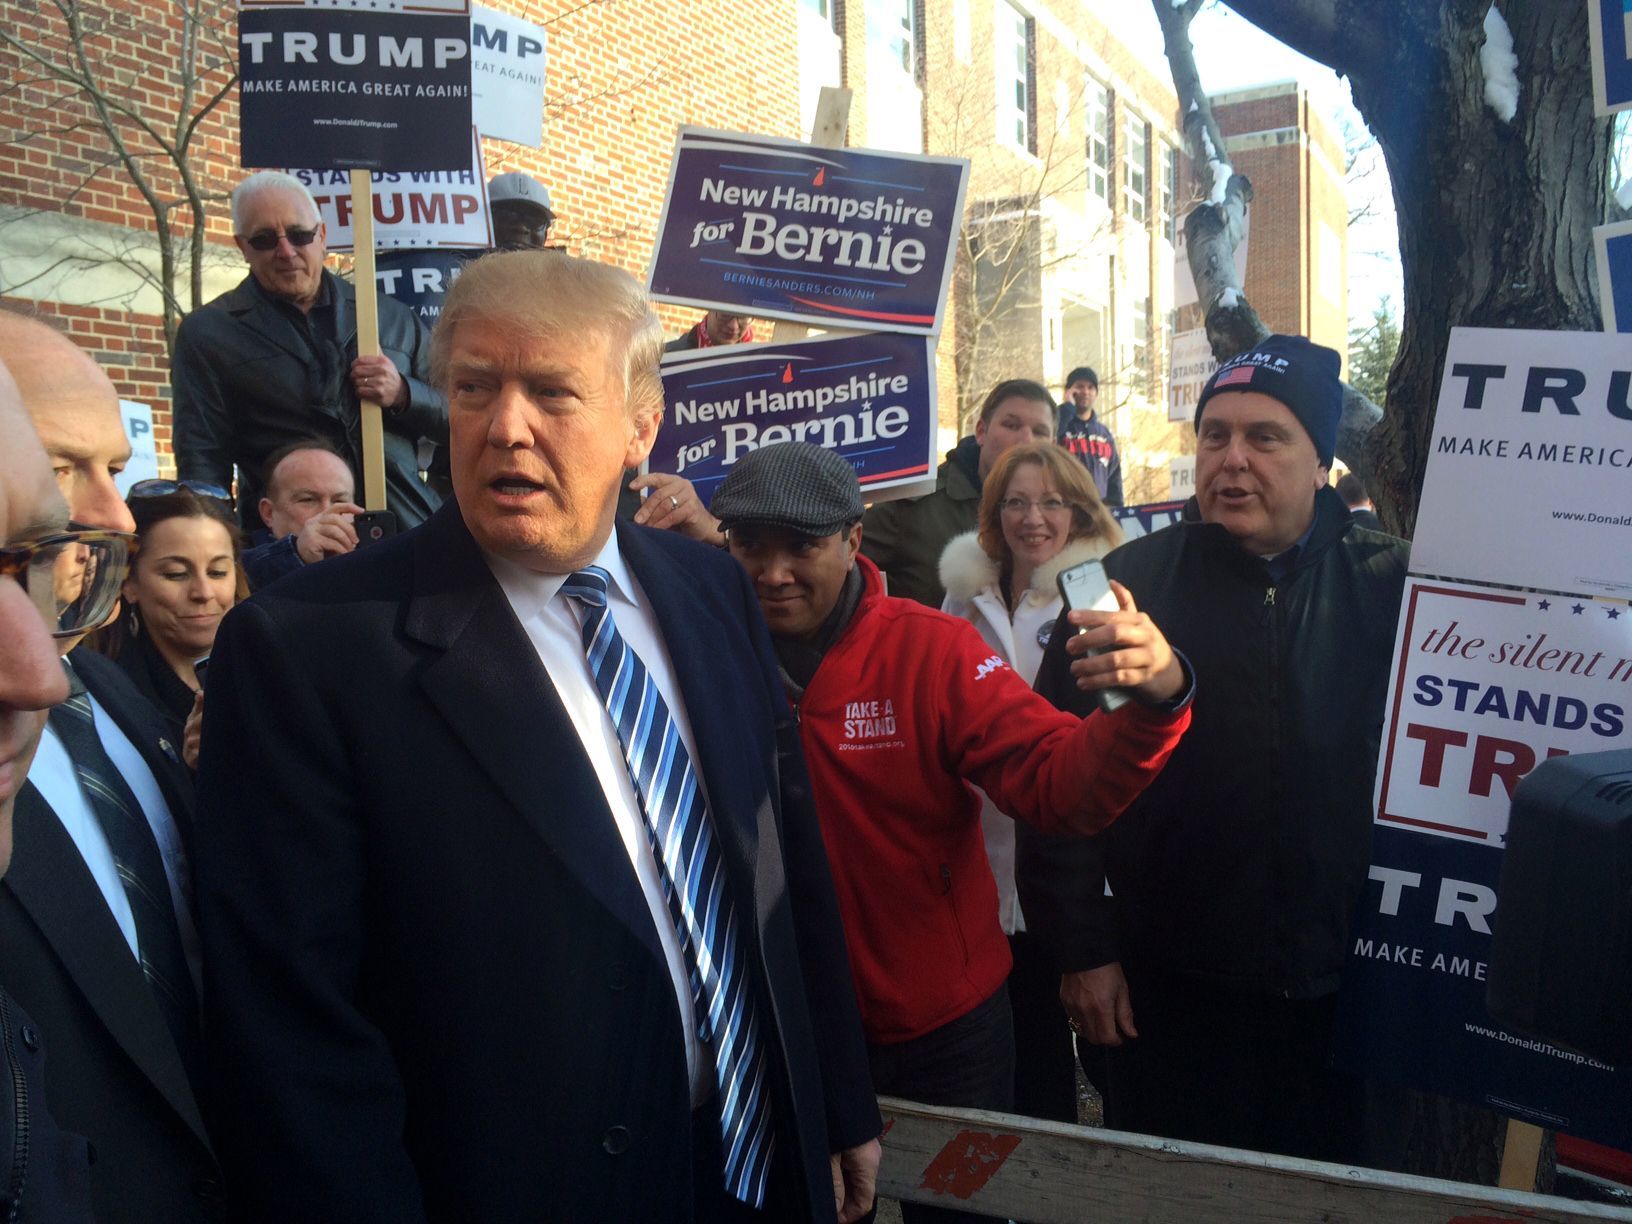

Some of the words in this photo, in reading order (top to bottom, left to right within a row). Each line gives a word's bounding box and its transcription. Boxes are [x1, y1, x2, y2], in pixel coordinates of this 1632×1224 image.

[241, 31, 468, 69] TRUMP
[242, 79, 284, 94] MAKE
[288, 80, 358, 94] AMERICA
[362, 82, 412, 97] GREAT
[415, 84, 468, 98] AGAIN!
[313, 117, 398, 130] www.DonaldJTrump.com
[297, 169, 401, 187] STADS
[411, 170, 475, 185] WITH
[700, 177, 767, 208] New
[771, 185, 933, 228] Hampshire
[690, 220, 735, 249] for
[735, 211, 926, 275] Bernie
[376, 267, 460, 295] TR
[723, 271, 875, 301] BERNIESANDERS.COM/NH
[1172, 363, 1204, 380] STANDS
[675, 397, 740, 426] New
[746, 372, 909, 416] Hampshire
[676, 437, 716, 473] for
[721, 400, 910, 466] Bernie
[1438, 436, 1510, 459] MAKE
[1420, 621, 1485, 660] the
[1488, 633, 1606, 678] silent
[846, 701, 880, 719] TAKE
[885, 699, 894, 715] A
[1413, 674, 1624, 738] STANDS
[844, 716, 896, 740] STAND
[1406, 723, 1570, 802] TR
[1354, 938, 1424, 967] MAKE
